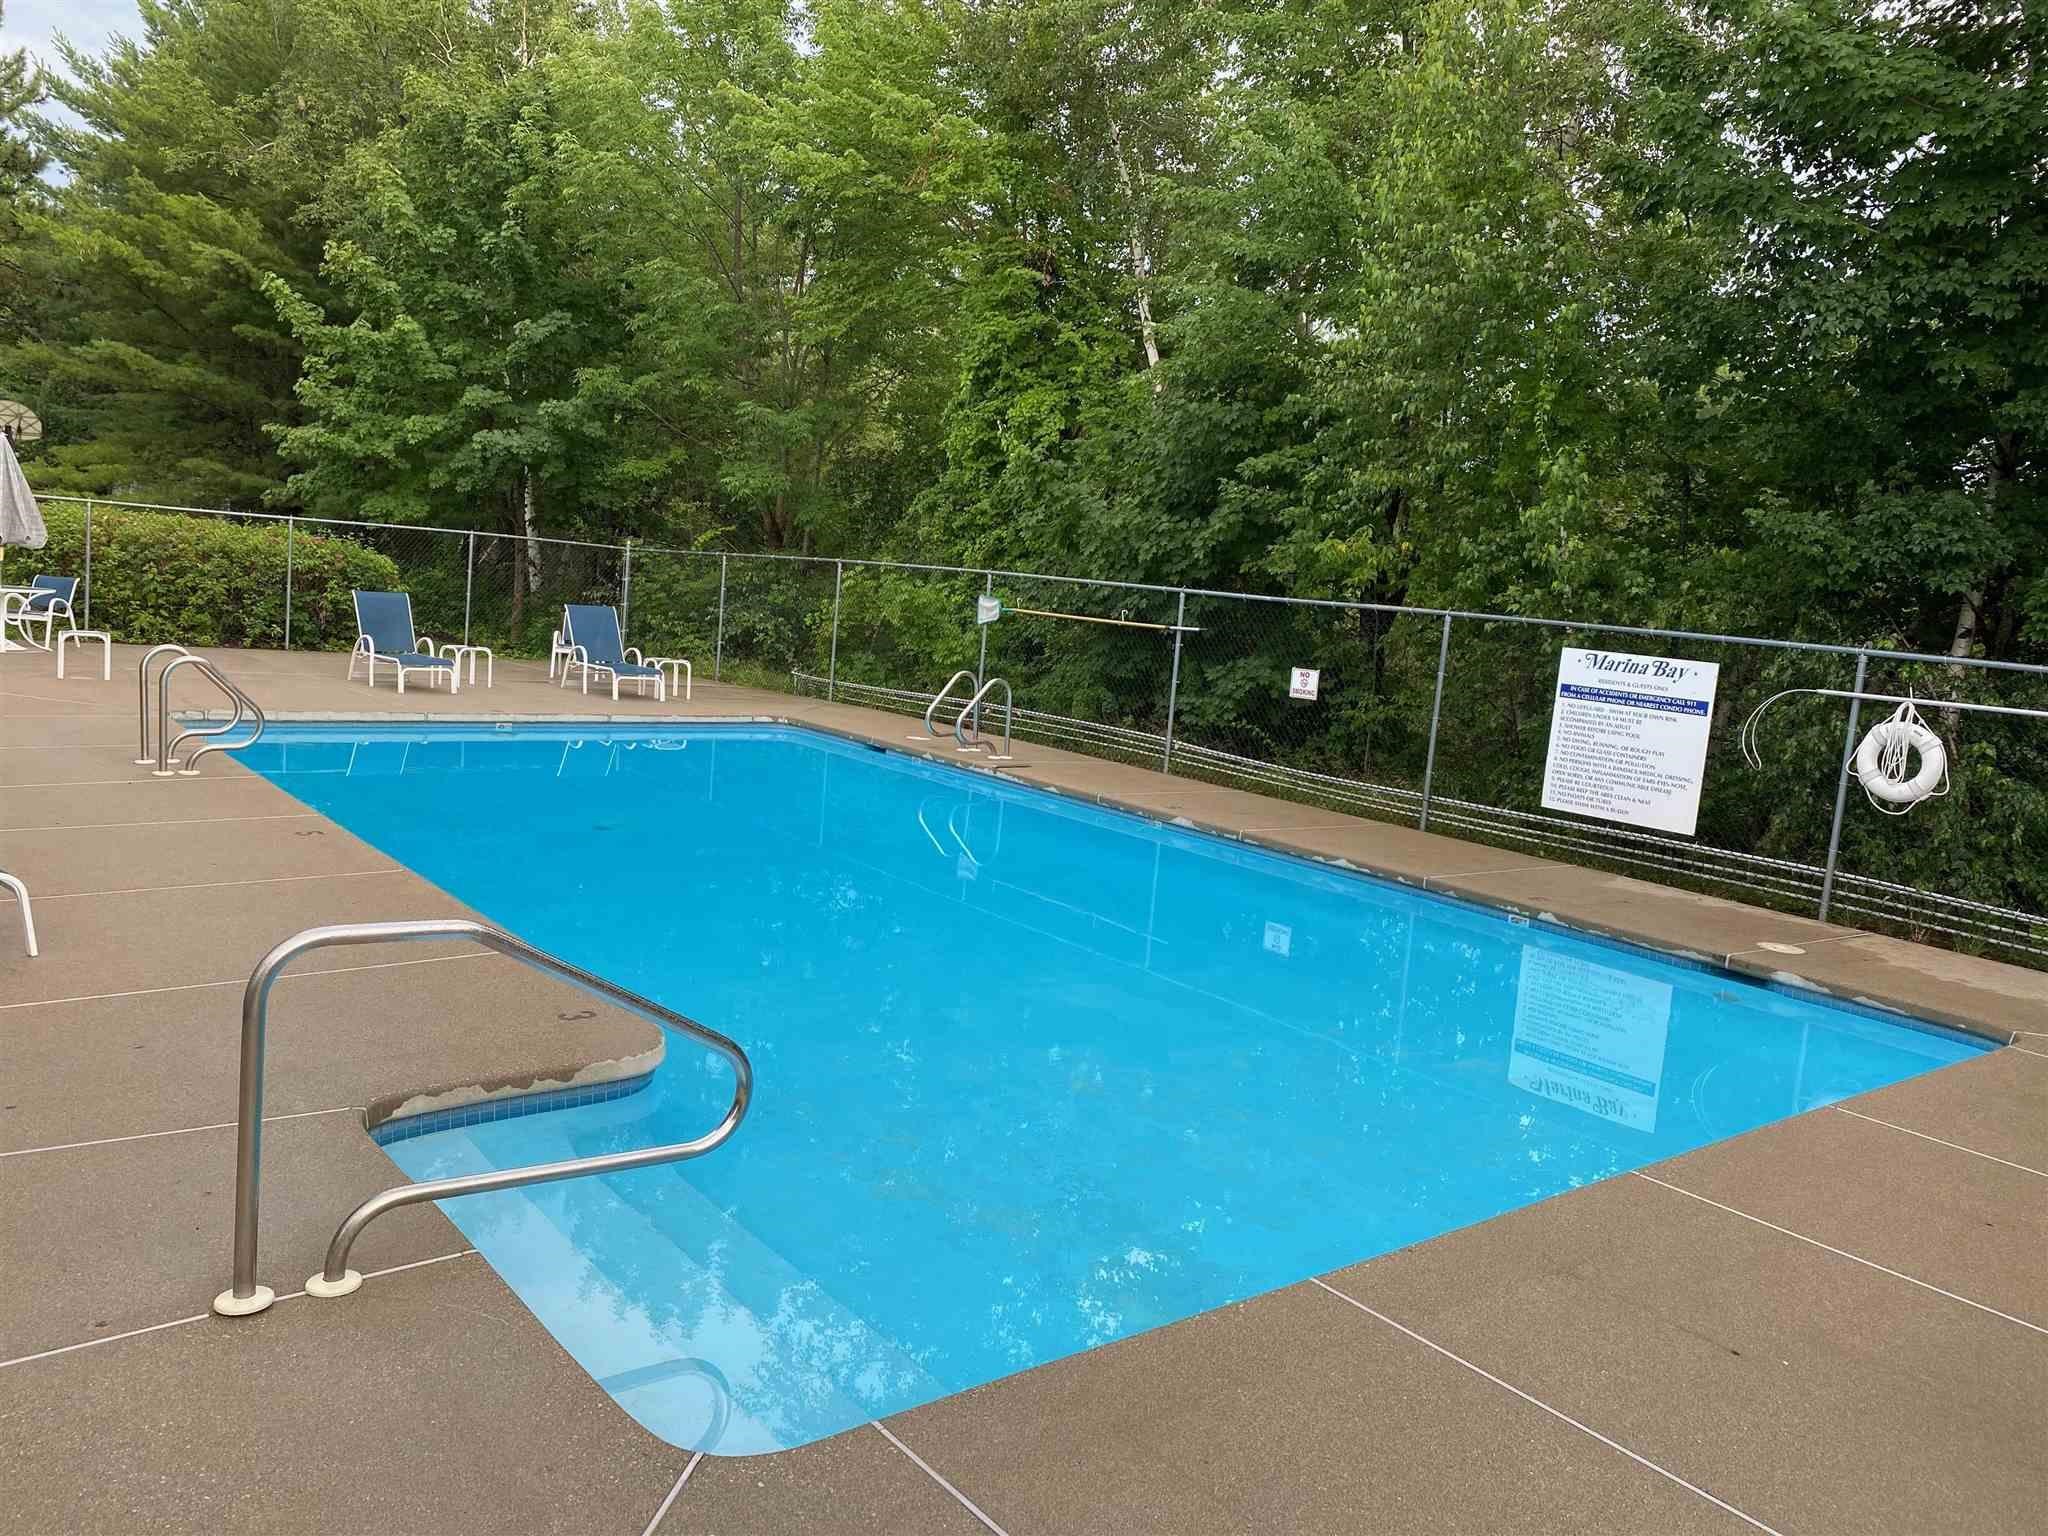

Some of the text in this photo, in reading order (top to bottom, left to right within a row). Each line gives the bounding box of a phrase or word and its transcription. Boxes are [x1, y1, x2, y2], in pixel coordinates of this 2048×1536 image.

[1584, 652, 1689, 684] Marina Bay
[1660, 704, 1682, 712] CONDO
